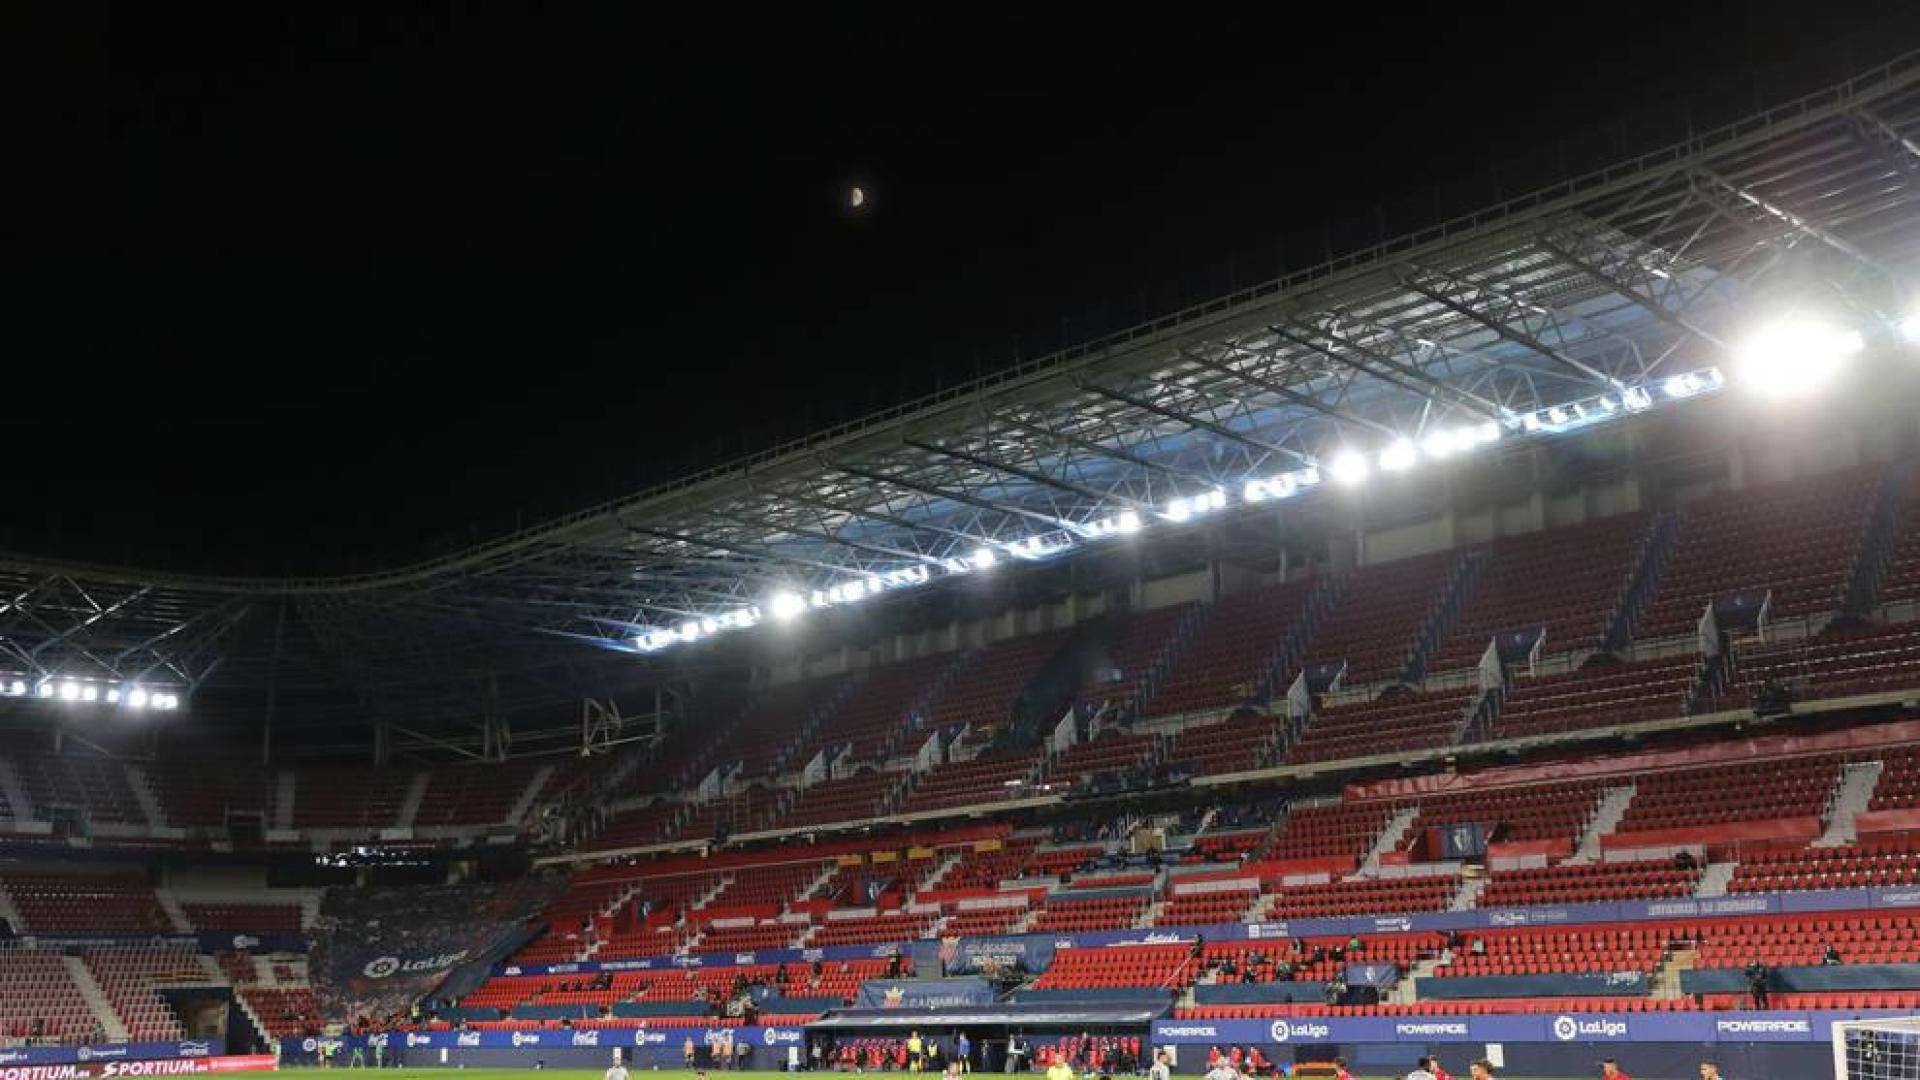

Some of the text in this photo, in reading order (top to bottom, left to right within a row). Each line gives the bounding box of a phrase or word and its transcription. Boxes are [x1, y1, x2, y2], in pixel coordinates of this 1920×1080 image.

[1158, 1026, 1216, 1036] POWERADE
[1290, 1023, 1328, 1037] LaLiga
[1396, 1023, 1468, 1035] POWERADE
[1579, 1019, 1626, 1036] LaLiga
[1717, 1020, 1810, 1032] POWERADE
